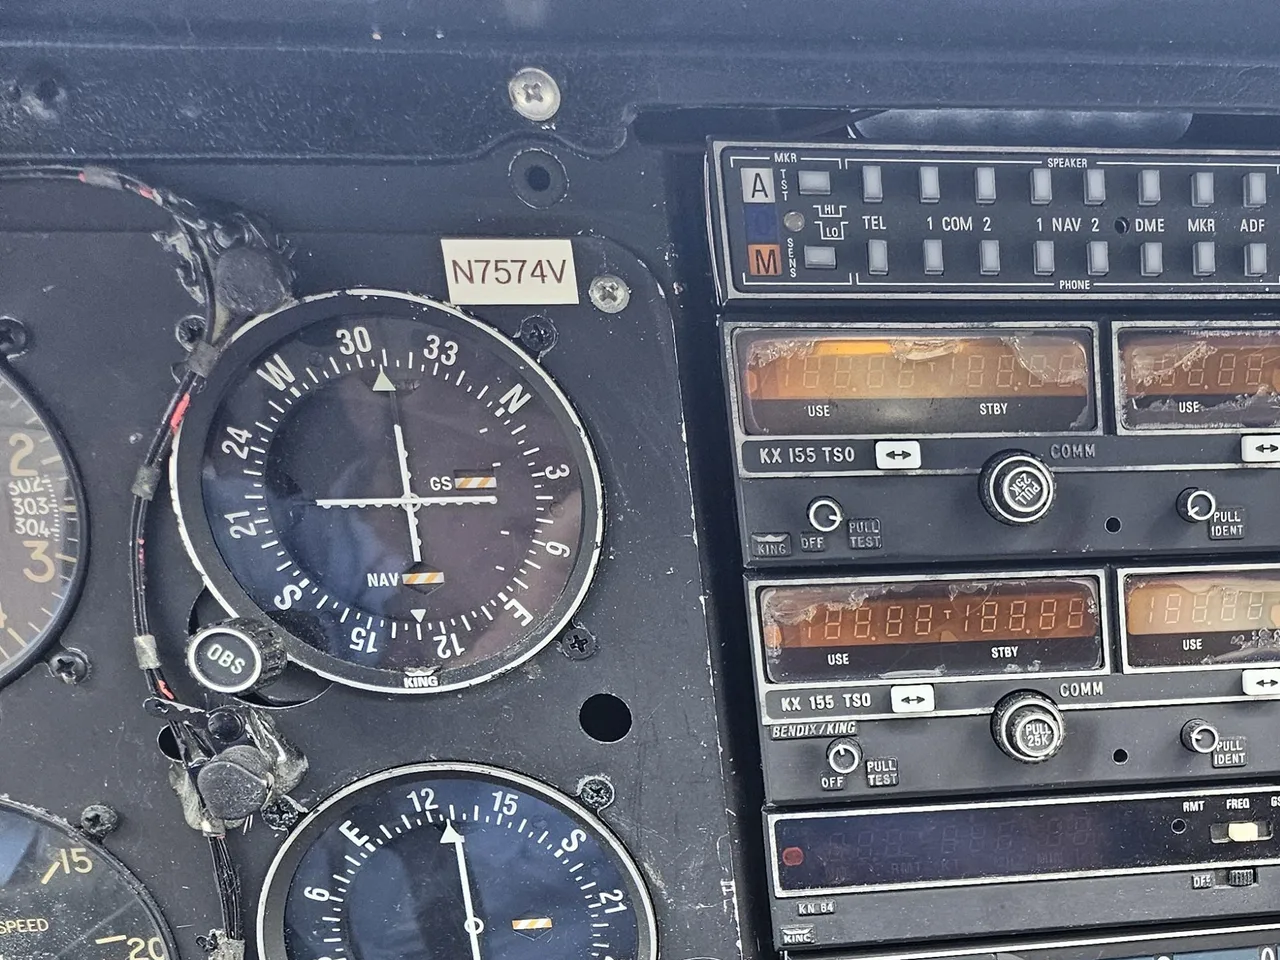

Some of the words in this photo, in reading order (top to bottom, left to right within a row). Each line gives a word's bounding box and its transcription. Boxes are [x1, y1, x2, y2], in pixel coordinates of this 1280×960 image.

[774, 153, 797, 163] MKR
[1047, 158, 1088, 169] SPEAKER
[751, 172, 769, 199] A
[862, 216, 887, 230] TEL
[942, 217, 973, 231] COM
[983, 217, 992, 231] 2
[1052, 218, 1081, 232] NAV
[1092, 219, 1100, 232] 2
[1135, 218, 1165, 233] DME
[1187, 218, 1215, 233] MKR
[1240, 218, 1265, 233] ADF
[451, 259, 567, 285] N7574V
[1059, 280, 1090, 290] PHONE
[335, 326, 373, 355] 30
[422, 334, 459, 366] 33
[979, 403, 1007, 415] STBY
[1050, 443, 1096, 459] COMM
[429, 475, 453, 491] GS
[15, 517, 51, 538] 30.4
[1211, 524, 1244, 537] IDENT
[367, 572, 399, 588] NAV
[991, 645, 1019, 658] STBY
[1182, 638, 1203, 651] USE
[206, 644, 247, 675] OBS
[828, 652, 850, 666] USE
[1060, 682, 1104, 697] COMM
[781, 697, 801, 712] KX
[809, 695, 834, 710] 155
[842, 693, 872, 708] TSO
[1214, 752, 1246, 765] IDENT
[866, 760, 897, 773] PULL
[821, 776, 844, 789] OFF
[406, 786, 439, 814] 12
[491, 791, 518, 817] 15
[0, 918, 49, 932] SPEED
